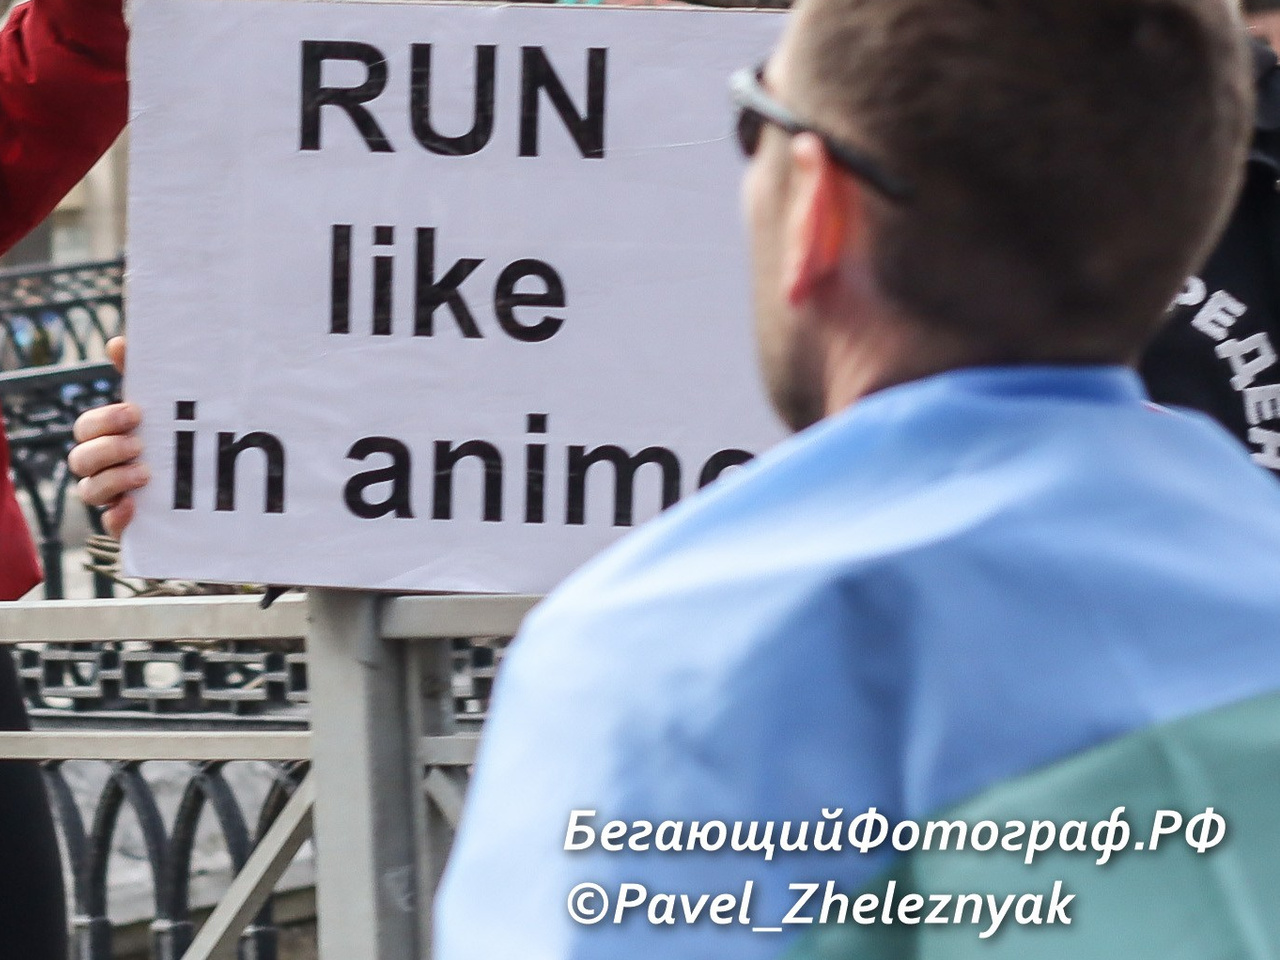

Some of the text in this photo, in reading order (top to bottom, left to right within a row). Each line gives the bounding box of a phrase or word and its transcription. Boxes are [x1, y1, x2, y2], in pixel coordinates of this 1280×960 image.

[299, 39, 609, 160] RUN
[329, 223, 566, 343] like
[172, 400, 286, 514] in
